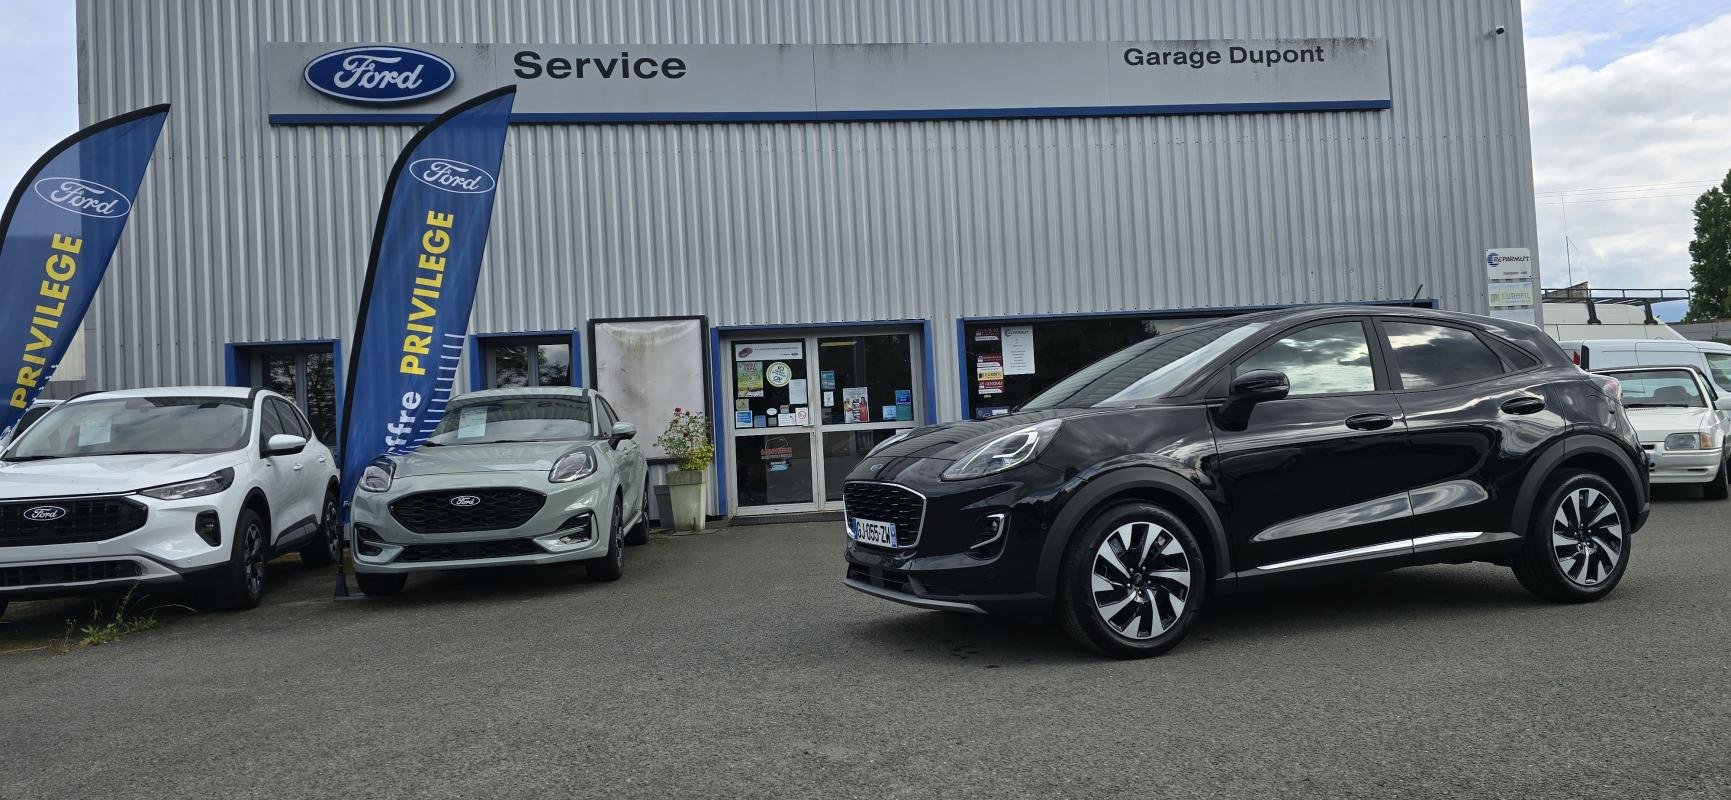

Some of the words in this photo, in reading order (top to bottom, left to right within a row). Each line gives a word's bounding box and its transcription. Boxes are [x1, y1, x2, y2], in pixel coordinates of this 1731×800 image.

[332, 54, 423, 90] Ford
[513, 50, 687, 80] Service
[1123, 47, 1222, 69] Garage
[1229, 45, 1325, 68] Dupont
[422, 161, 483, 191] Ford
[50, 181, 114, 215] Ford
[400, 210, 454, 376] PRIVILEGE
[10, 233, 83, 409] PRIVILEGE
[386, 391, 422, 455] ffre
